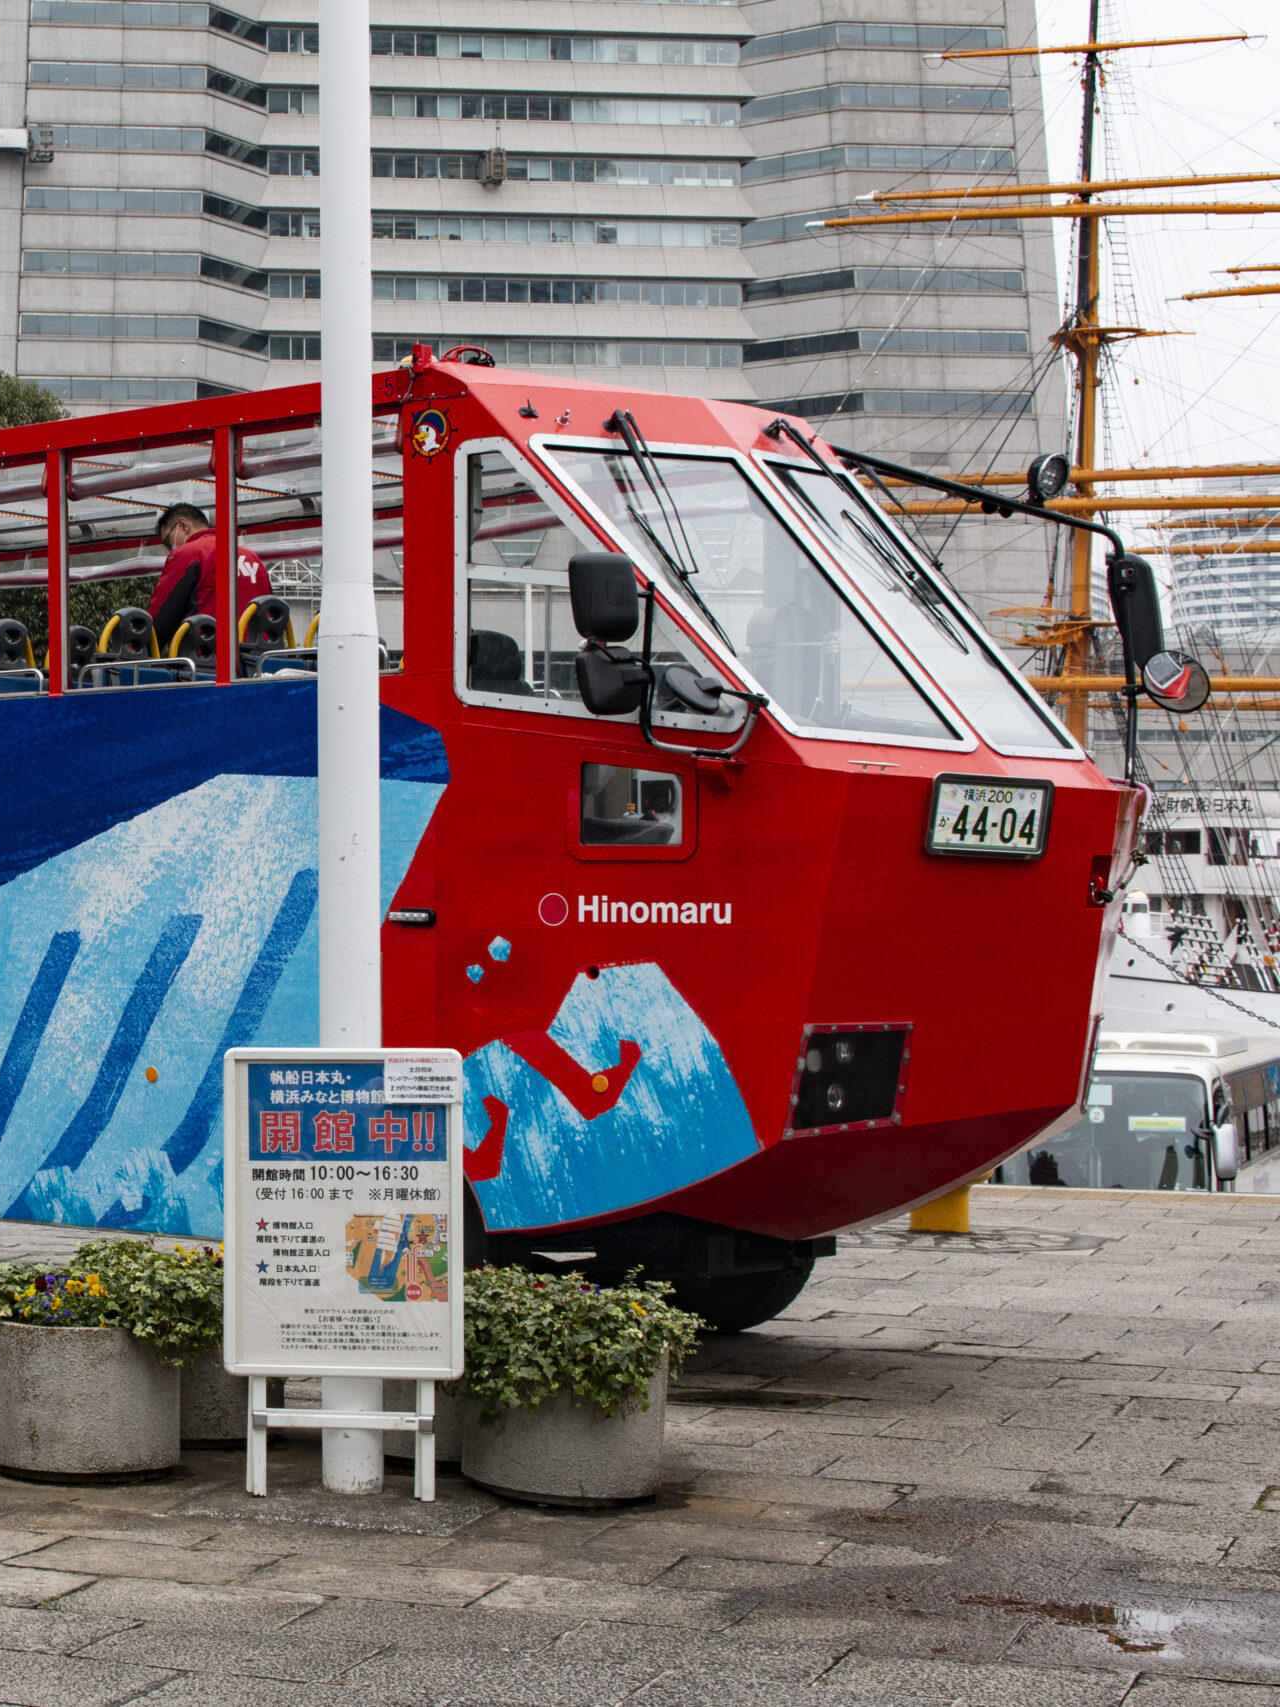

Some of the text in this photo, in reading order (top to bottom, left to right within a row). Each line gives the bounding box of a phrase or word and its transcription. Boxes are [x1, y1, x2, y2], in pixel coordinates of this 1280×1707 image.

[238, 555, 260, 584] KY
[938, 804, 1037, 845] か 44-04
[578, 895, 732, 925] Hinomaru
[252, 1168, 306, 1182] 開館時間
[273, 1222, 314, 1230] 博物館入口
[256, 1235, 325, 1244] 階段を下りて直進の
[273, 1249, 330, 1257] 博物館正面入口
[260, 1278, 320, 1287] 階段を下りて直進
